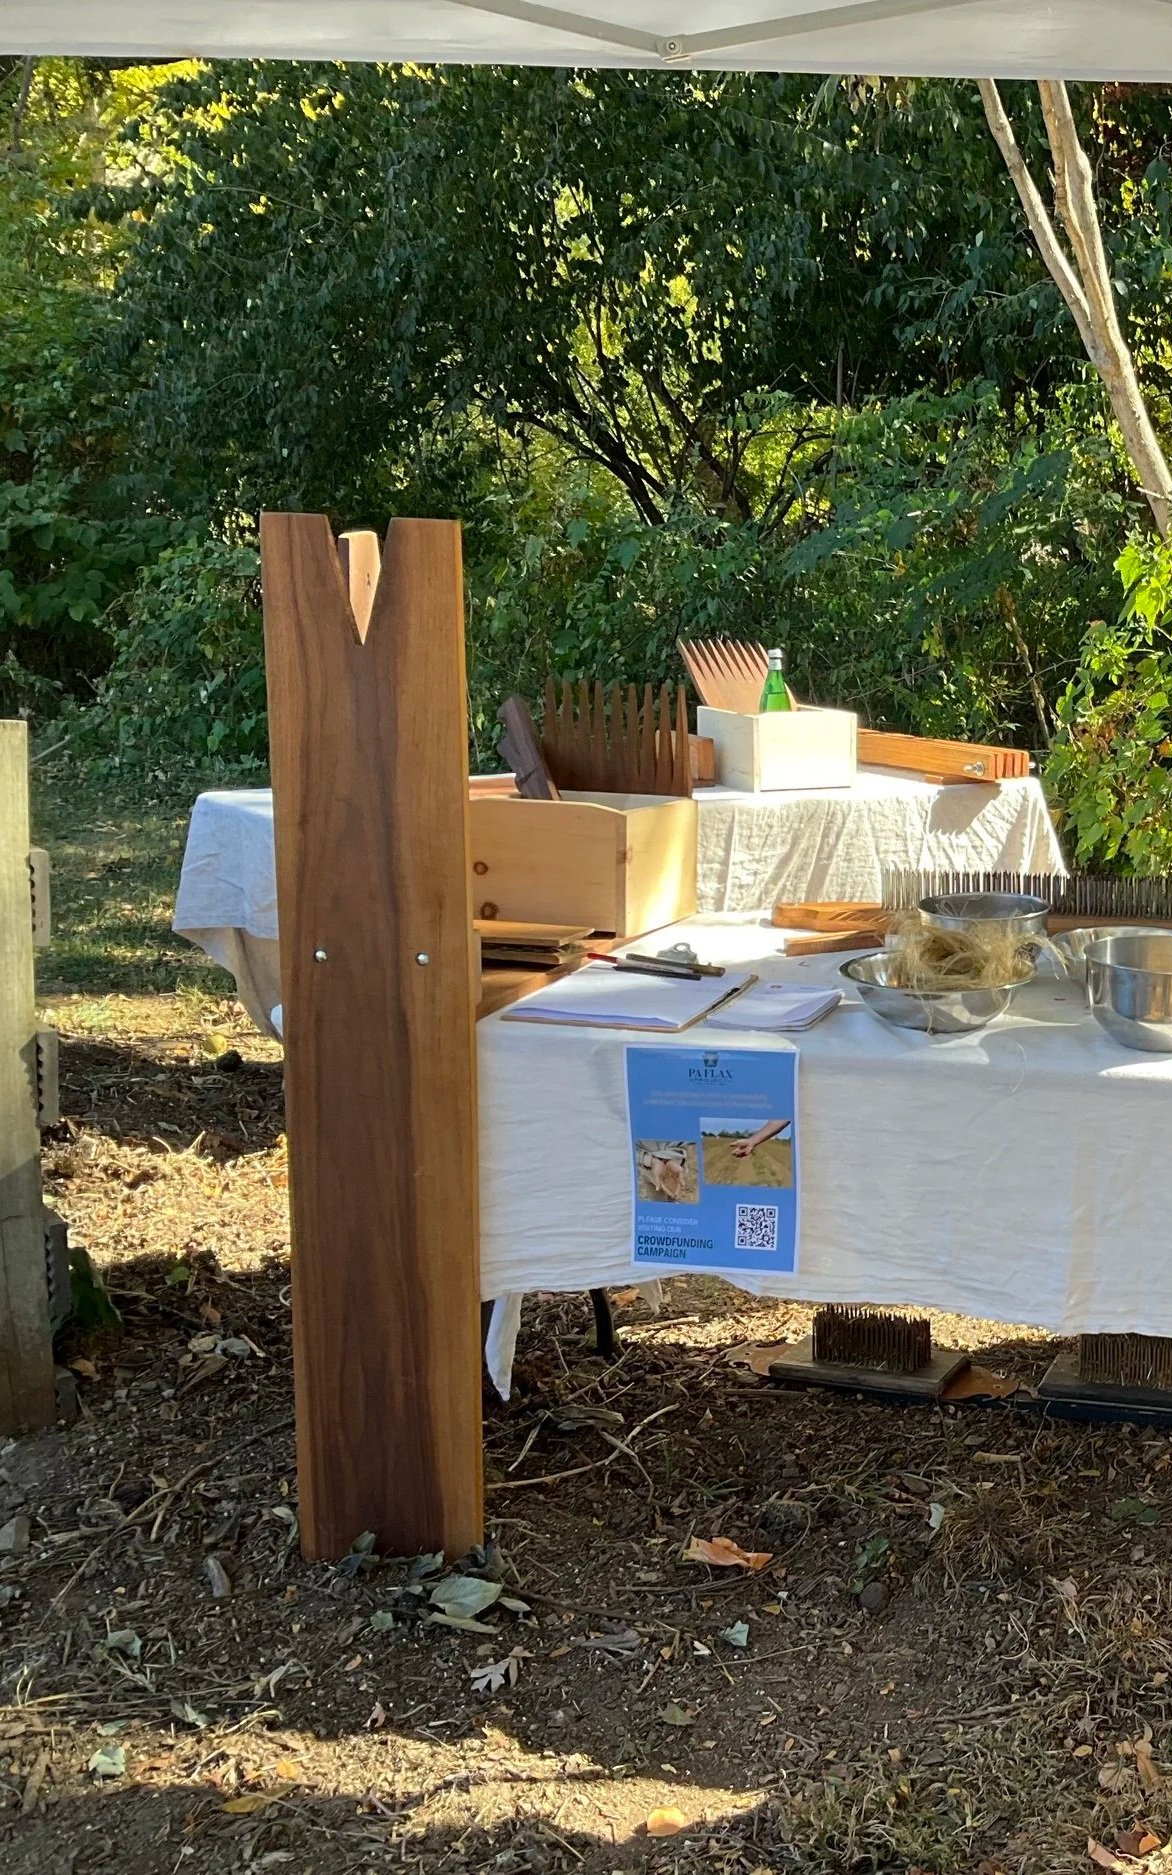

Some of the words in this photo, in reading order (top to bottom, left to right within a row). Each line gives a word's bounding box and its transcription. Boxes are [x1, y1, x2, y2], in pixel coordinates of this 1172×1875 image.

[688, 1068, 702, 1078] PA
[704, 1068, 733, 1079] FLAX
[664, 1217, 698, 1225] CONSIDER
[637, 1235, 713, 1249] CROWDFUNDING
[637, 1246, 687, 1259] CAMPAIGN
